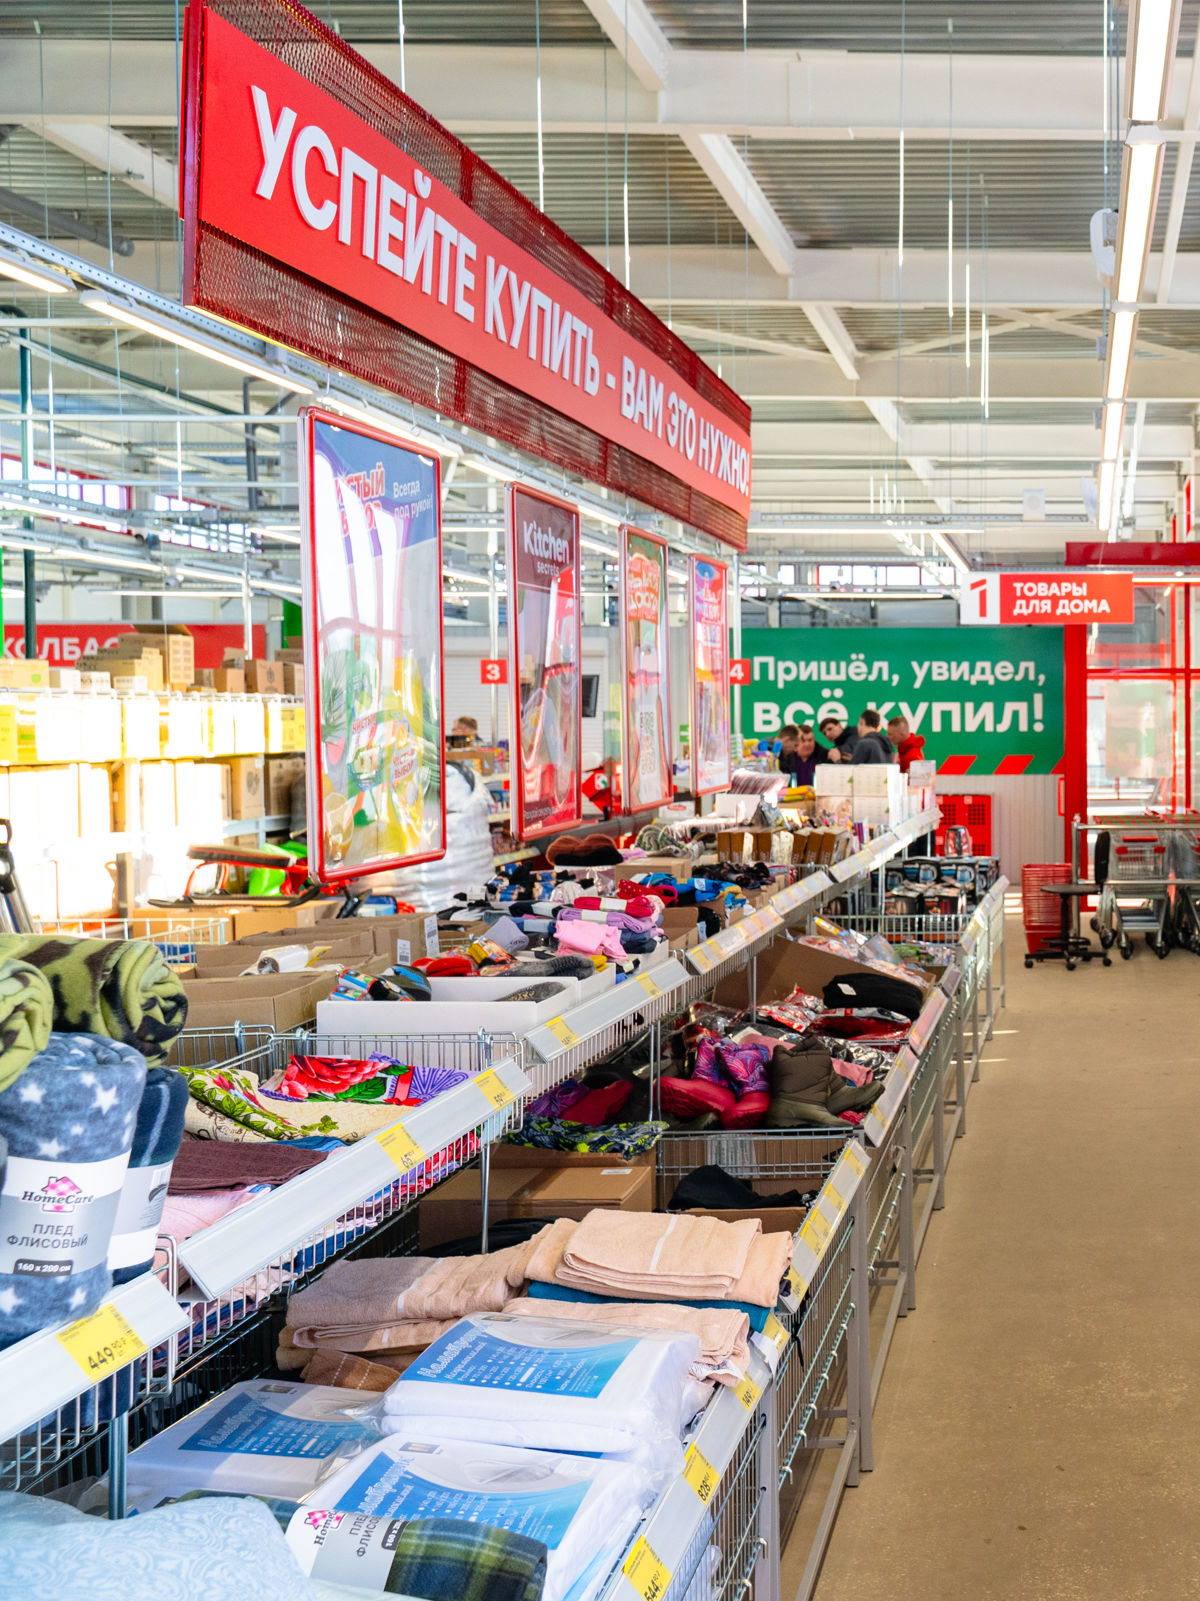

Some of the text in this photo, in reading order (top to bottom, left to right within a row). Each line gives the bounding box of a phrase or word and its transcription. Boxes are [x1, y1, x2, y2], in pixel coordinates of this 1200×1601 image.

[250, 84, 477, 324] УСПЕЙТЕ
[484, 256, 601, 397] КУПИТЬ
[621, 355, 664, 438] ВАМ
[666, 391, 698, 462] ЭТО
[697, 417, 748, 496] НУЖНО!
[344, 461, 386, 501] СТЫЙ
[393, 480, 420, 498] Всегда
[394, 503, 410, 521] под
[523, 519, 570, 564] Kitchen
[537, 561, 560, 577] secrets
[970, 577, 988, 618] 1
[1012, 581, 1088, 598] ТОВАРЫ
[1012, 597, 1111, 615] ДЛЯ ДОМА
[486, 664, 500, 680] 3
[730, 663, 744, 681] 4
[752, 652, 1046, 688] Пришёл, увидел,
[752, 690, 1045, 735] всё купил!
[32, 1223, 74, 1237] ПЛЕД
[6, 1234, 89, 1249] ФЛИСОВЫЙ
[17, 1262, 34, 1271] 160
[43, 1263, 59, 1273] 200
[88, 1346, 115, 1370] 449
[698, 1480, 711, 1502] 828
[349, 1516, 368, 1535] ПЛЕ
[356, 1516, 380, 1557] ФЛИСО
